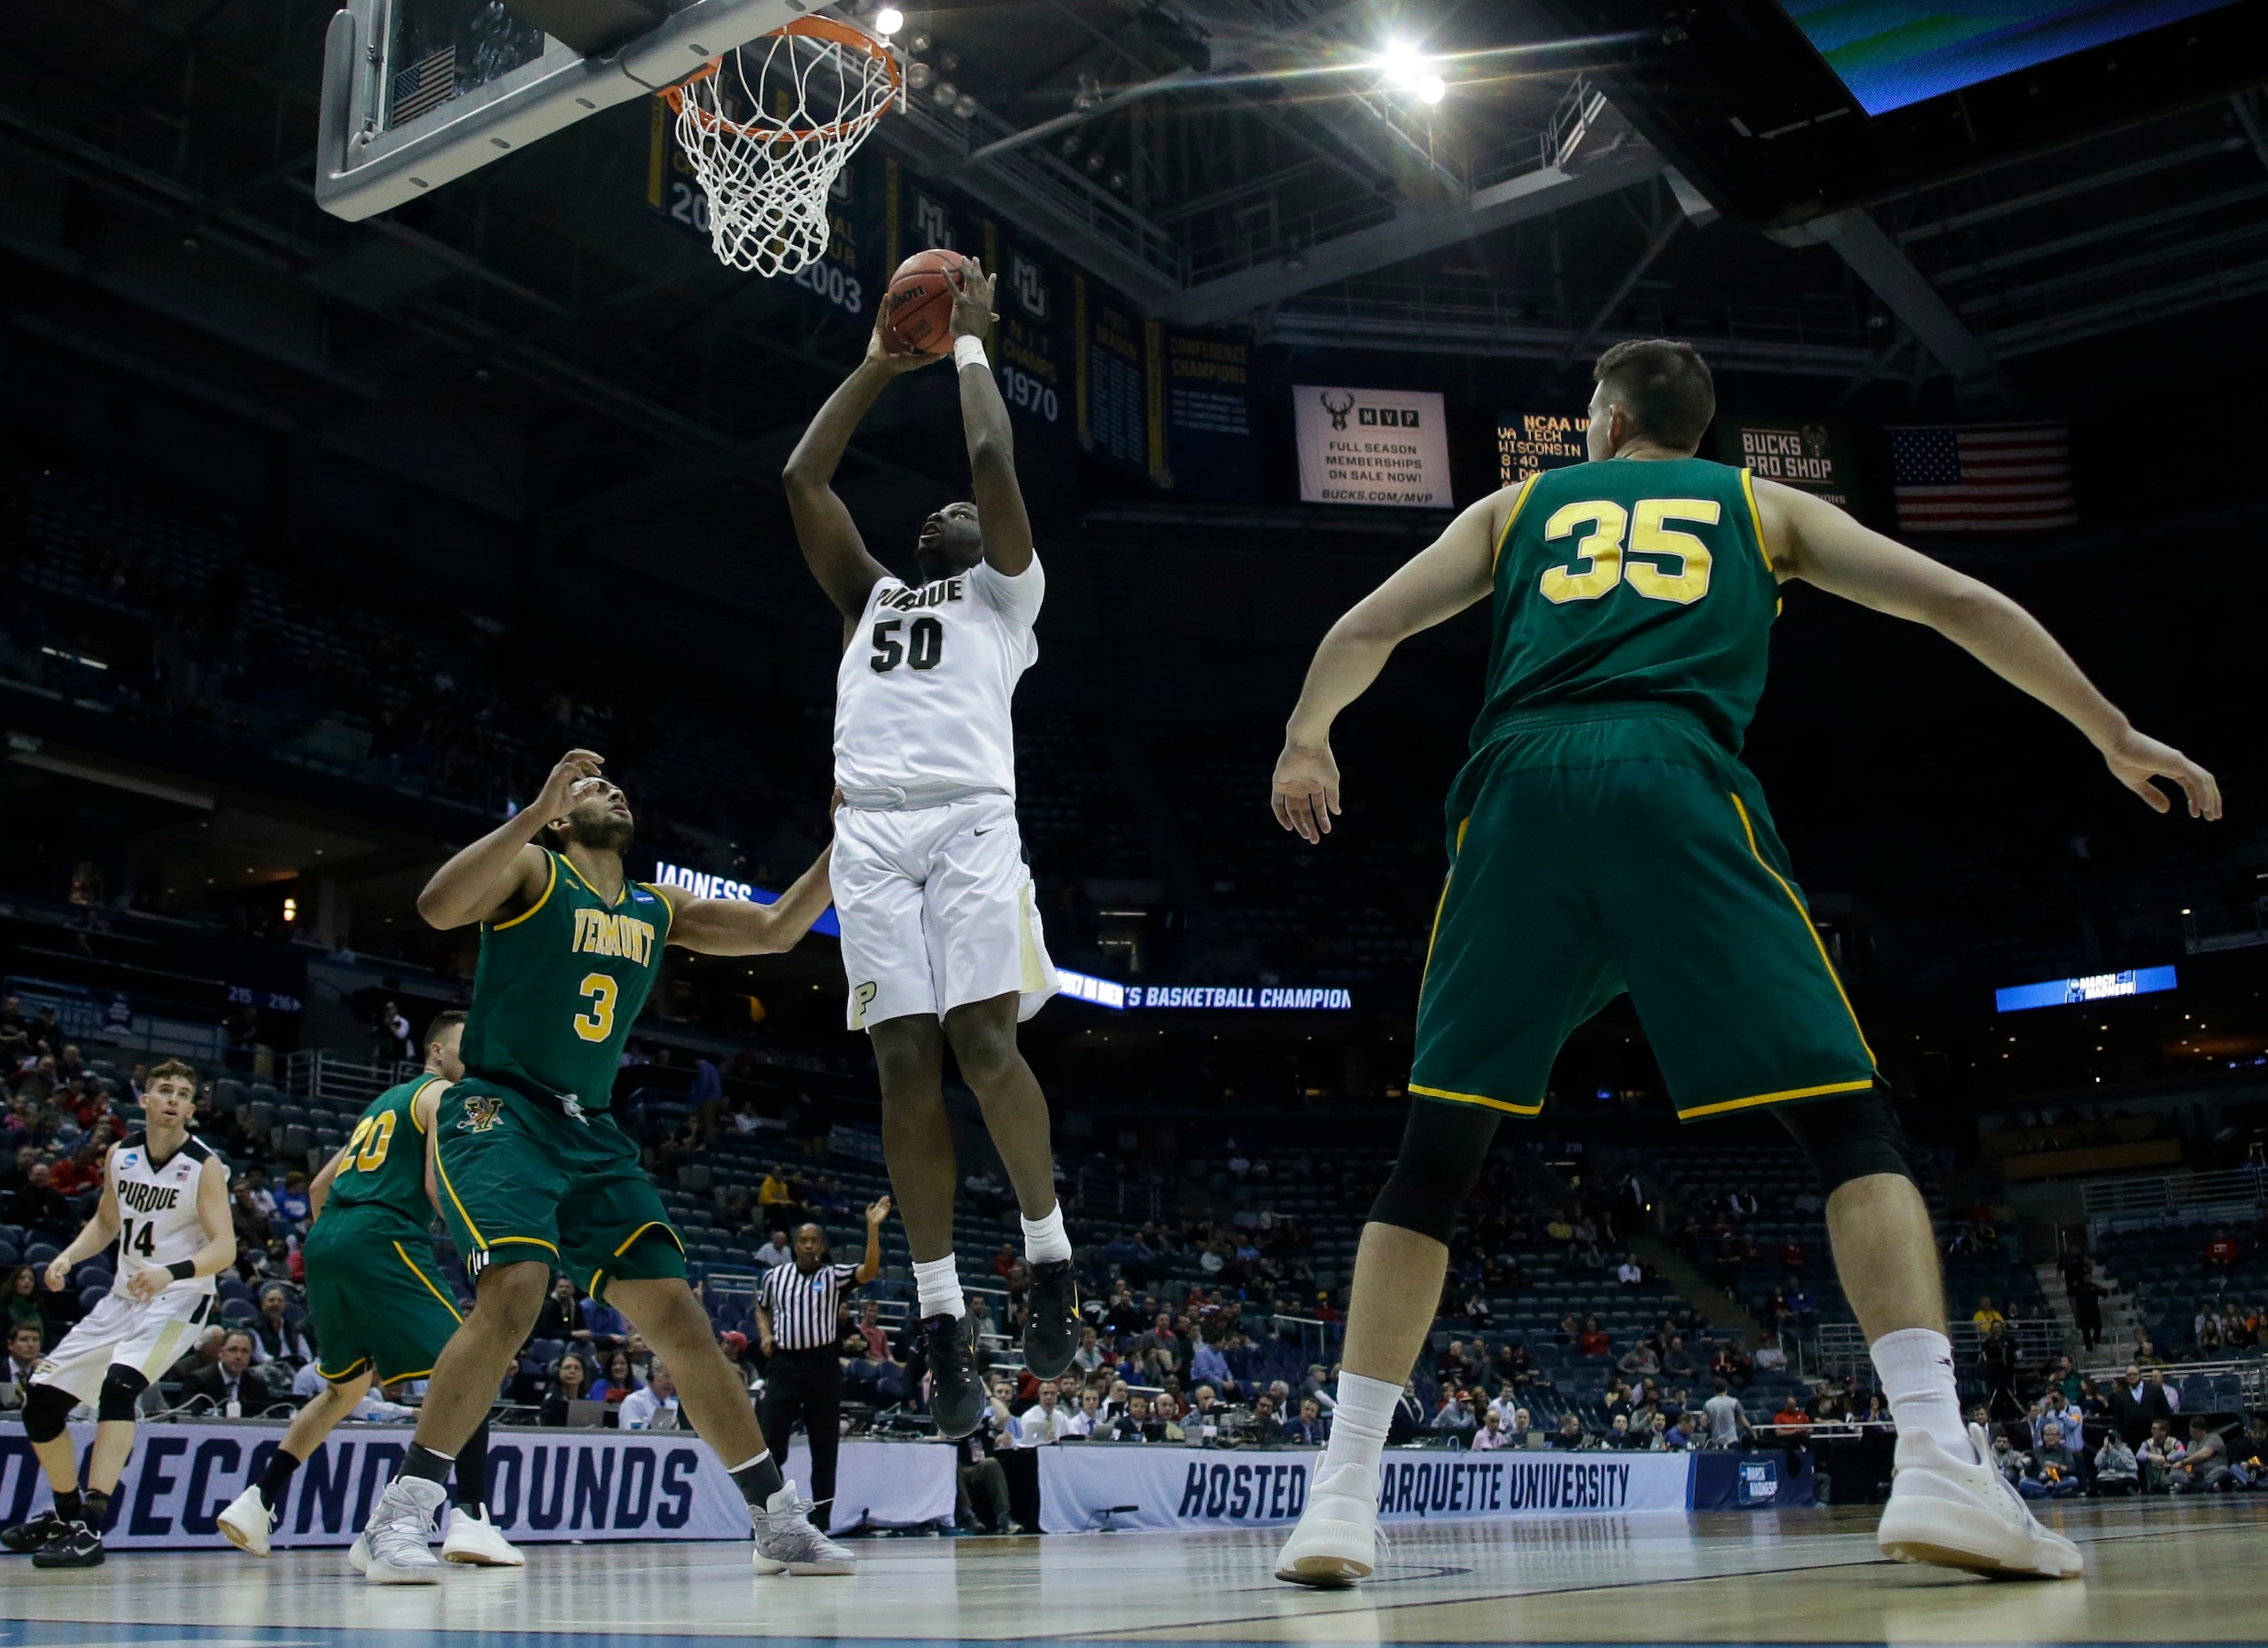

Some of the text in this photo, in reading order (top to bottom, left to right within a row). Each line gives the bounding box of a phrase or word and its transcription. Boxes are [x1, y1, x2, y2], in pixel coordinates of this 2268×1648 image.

[1172, 358, 1247, 385] CHAMPIONS
[1002, 365, 1059, 422] 1970
[1497, 426, 1564, 443] VA TECH
[1524, 415, 1572, 432] NCAA
[1330, 441, 1417, 455] FULL SEASON
[1498, 440, 1581, 457] WISCONSIN
[1742, 432, 1802, 455] BUCKS
[1326, 455, 1422, 470] MEMBERSHIPS
[1501, 454, 1540, 468] 8:40
[1744, 454, 1833, 479] PRO SHOP
[1329, 470, 1422, 484] ON SALE NOW!
[1322, 489, 1433, 504] BUCKS.COM/MVP
[1540, 498, 1721, 605] 35
[870, 617, 943, 673] 50
[572, 907, 656, 968] VERMONT
[573, 972, 618, 1044] 3
[1146, 987, 1254, 1008] BASKETBALL
[336, 1109, 398, 1178] 20
[118, 1179, 181, 1214] PURDUE
[122, 1217, 155, 1257] 14
[441, 1444, 700, 1531] OUNDS
[1177, 1462, 1630, 1519] HOSTED ARQUETTE UNIVERSITY
